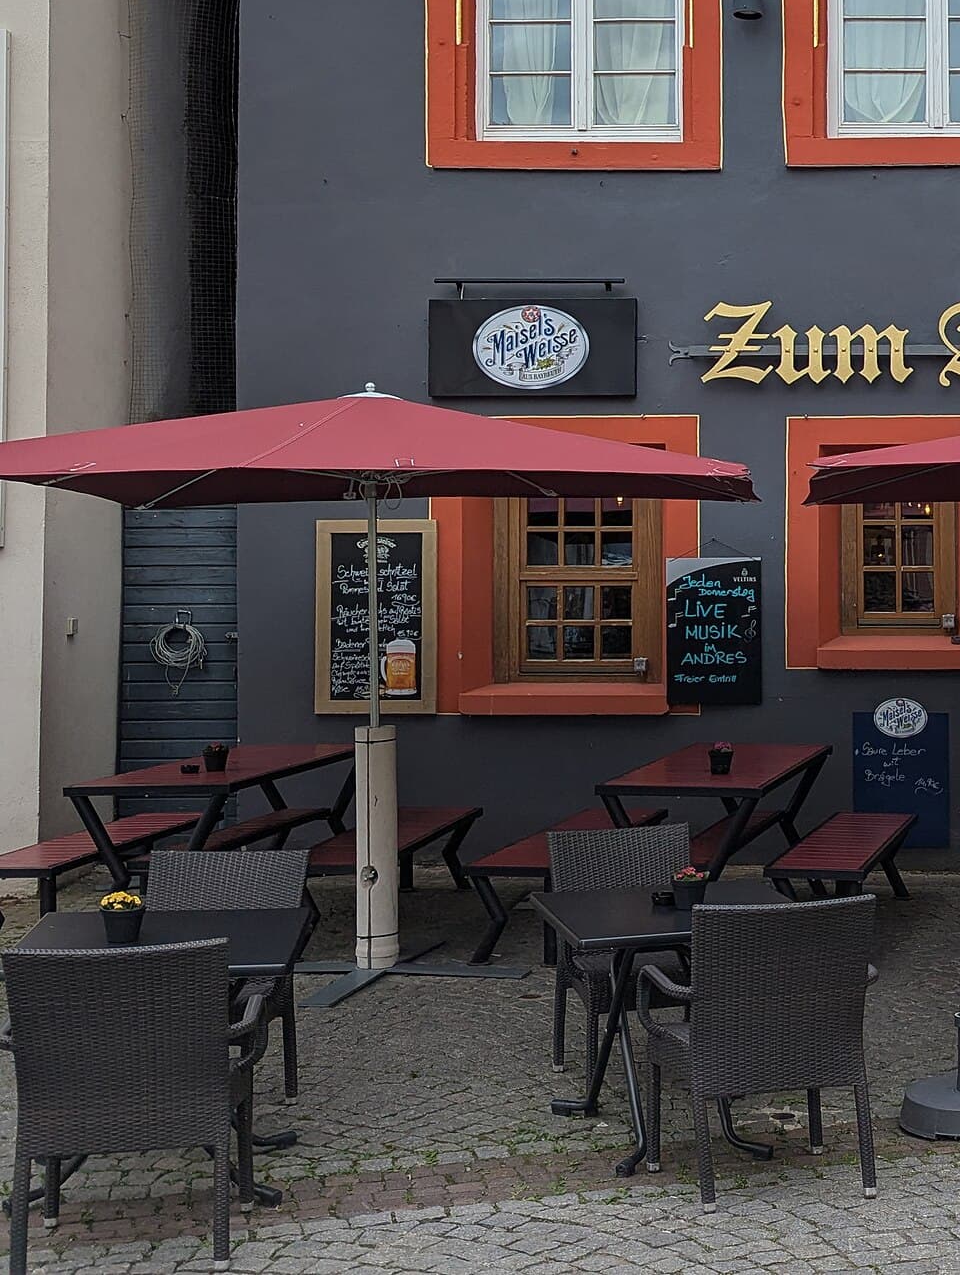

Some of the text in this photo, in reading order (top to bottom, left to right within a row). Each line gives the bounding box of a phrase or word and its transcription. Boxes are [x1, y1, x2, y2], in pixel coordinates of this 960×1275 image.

[485, 313, 555, 367] Maisel's
[515, 328, 579, 369] Weisse
[700, 300, 913, 385] Zum
[680, 651, 747, 666] ANDRES
[892, 742, 927, 756] Leber
